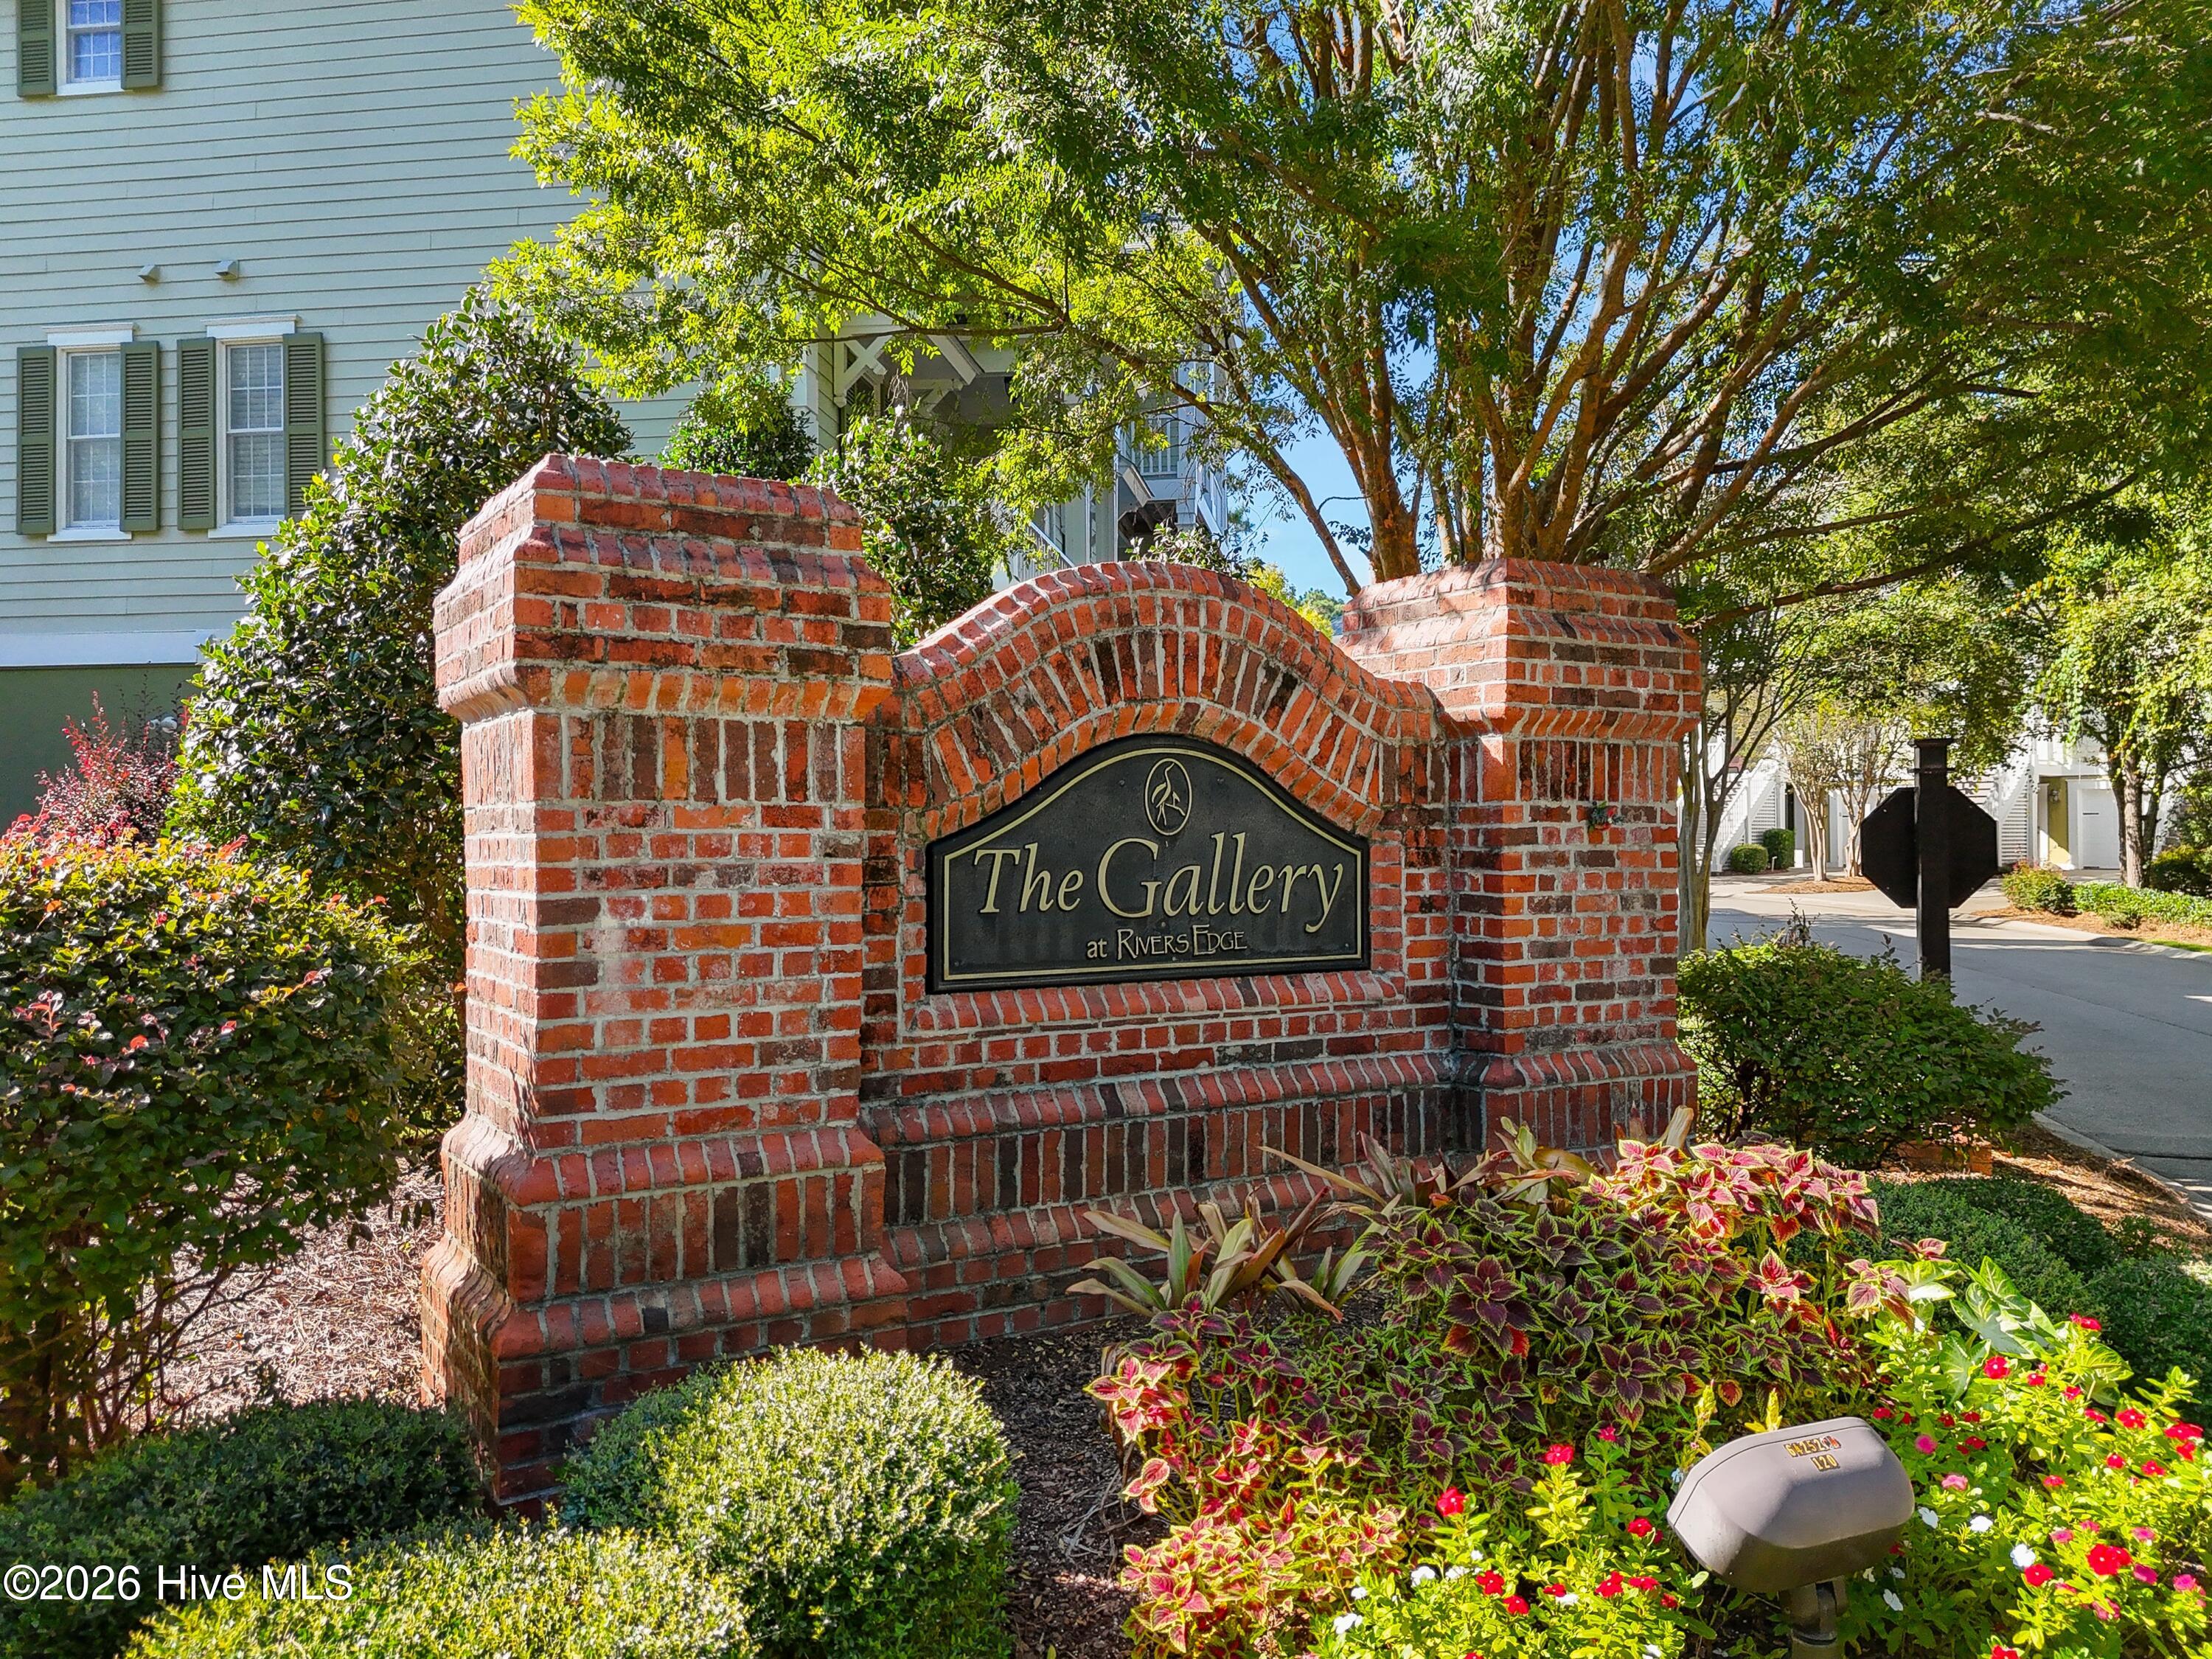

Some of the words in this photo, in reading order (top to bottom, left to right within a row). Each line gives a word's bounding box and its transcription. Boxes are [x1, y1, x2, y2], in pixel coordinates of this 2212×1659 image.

[973, 842, 1084, 914] The
[1097, 832, 1344, 933] Gallery
[1086, 938, 1107, 959] at
[1812, 1453, 1838, 1470] 120
